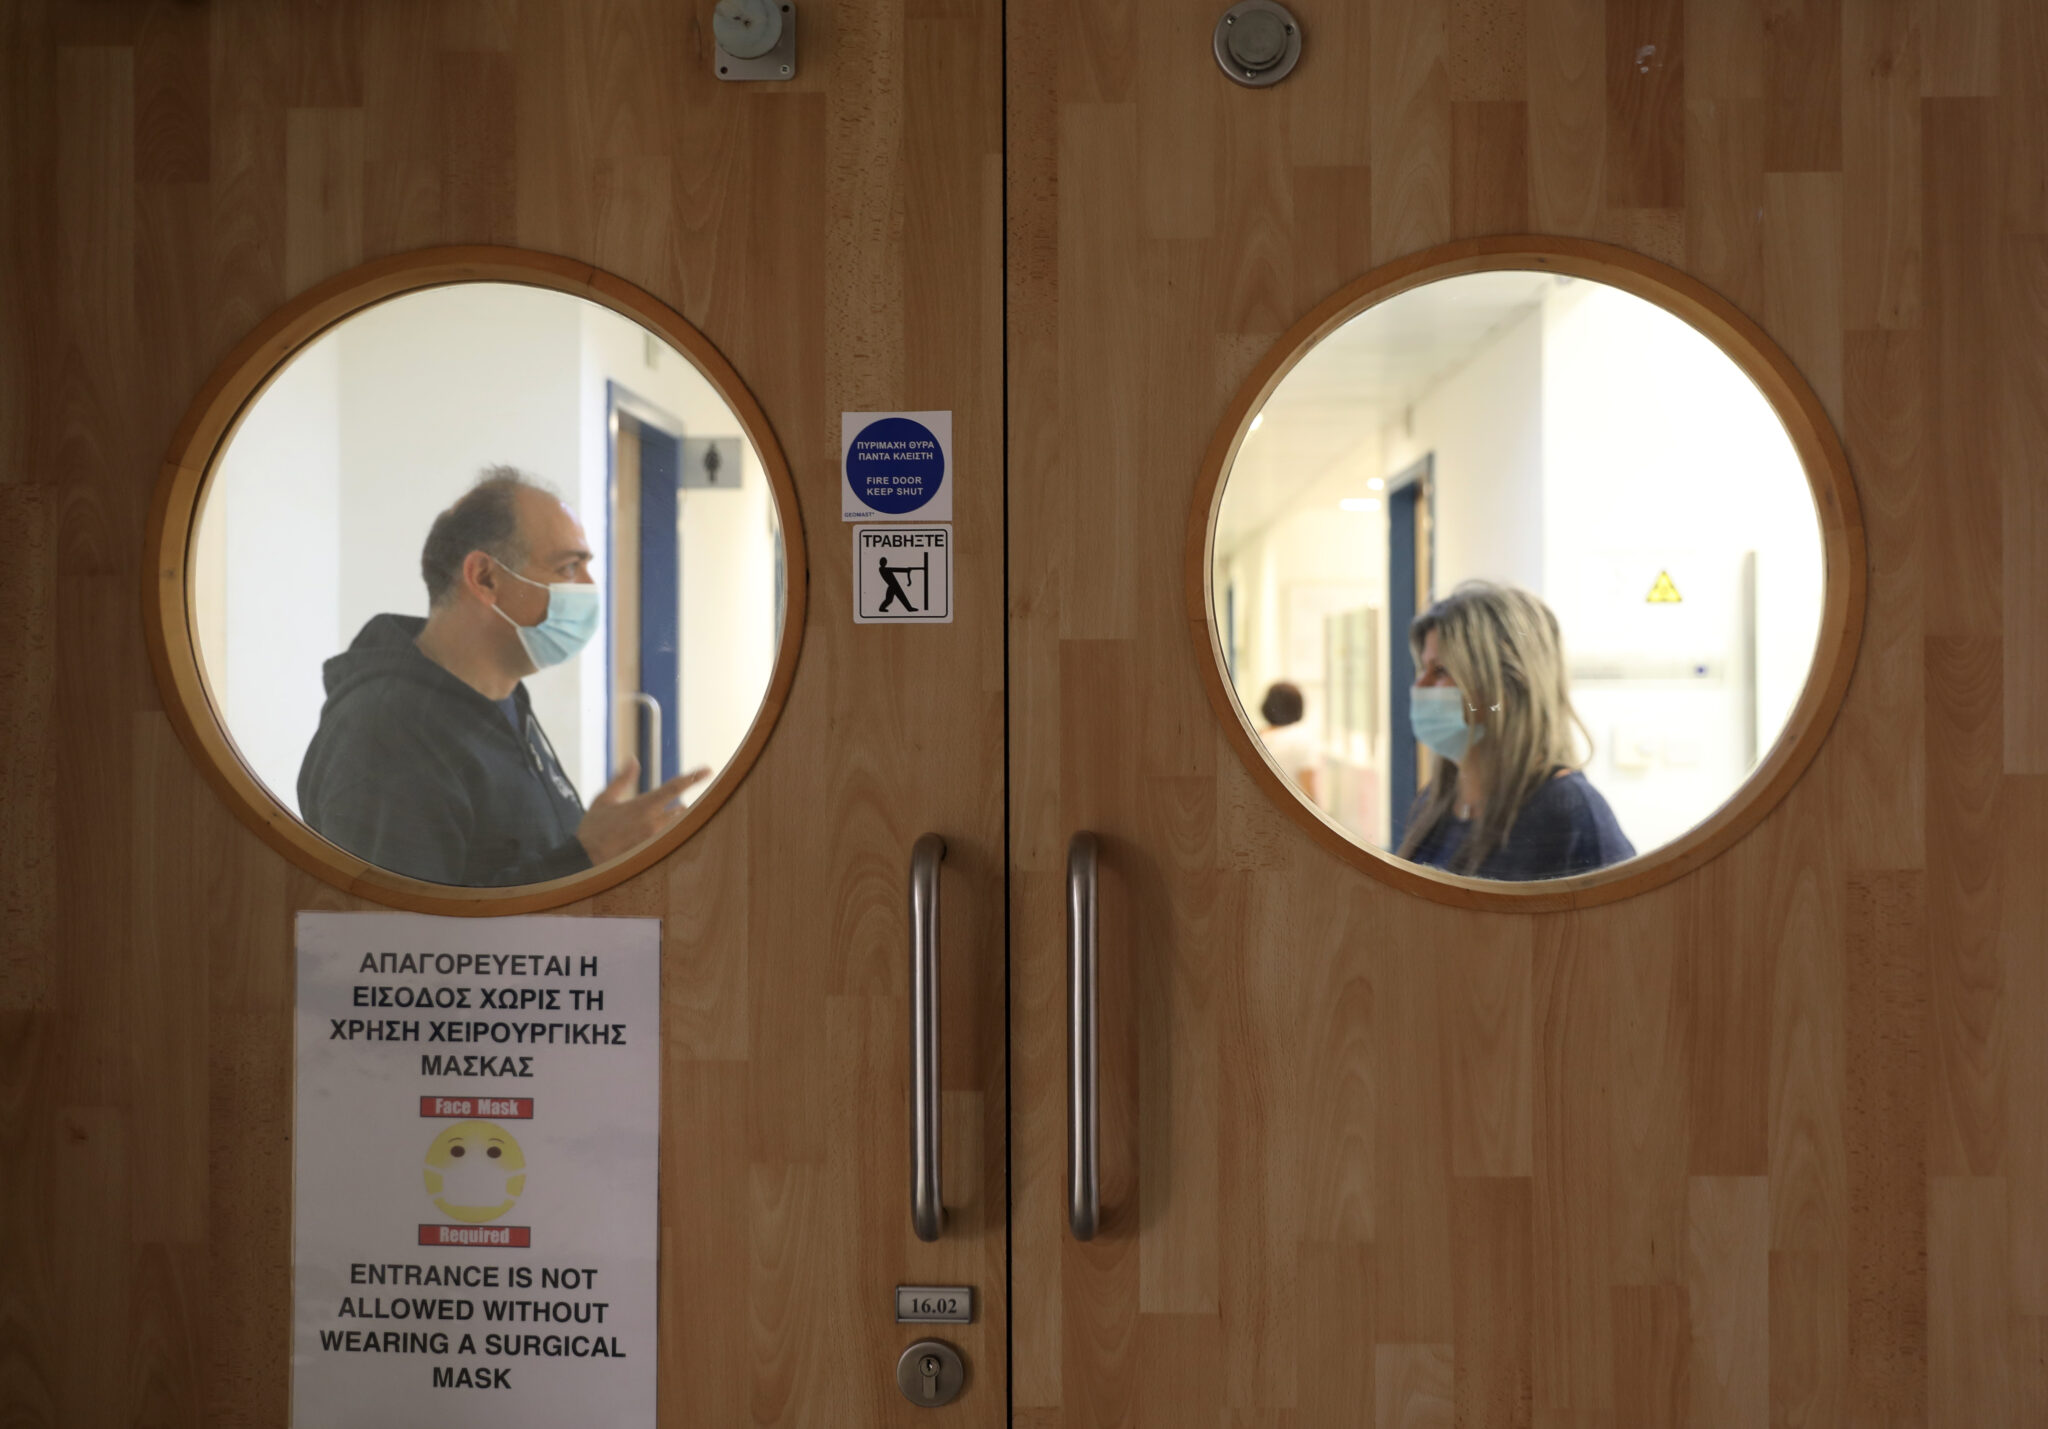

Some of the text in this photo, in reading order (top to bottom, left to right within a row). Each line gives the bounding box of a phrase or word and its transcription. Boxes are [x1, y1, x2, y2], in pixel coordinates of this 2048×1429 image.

[857, 441, 934, 450] ΠΥΡΙΜΑΧΗ ΘΥΡΑ
[893, 452, 933, 460] ΚΛΕΙΣΤΗ
[867, 488, 893, 496] KEEP
[863, 535, 944, 547] ΤΡΑΒΗΞΤΕ
[359, 953, 598, 977] ΑΠΑΓΟΡΕΥΕΤΑΙ Η
[352, 987, 604, 1011] ΕΙΣΟΔΟΣ ΧΩΡΙΣ ΤΗ
[330, 1019, 626, 1045] ΧΡΗΣΗ ΧΕΙΡΟΥΡΓΙΚΗΣ
[420, 1055, 534, 1077] ΜΑΣΚΑΣ
[435, 1098, 519, 1116] Face Mask
[440, 1226, 510, 1245] Required
[350, 1264, 598, 1289] ENTRANCE IS NOT
[338, 1298, 609, 1324] ALLOWED WITHOUT
[912, 1298, 957, 1313] 16.02
[320, 1330, 625, 1357] WEARING A SURGICAL
[433, 1367, 511, 1389] MASK
